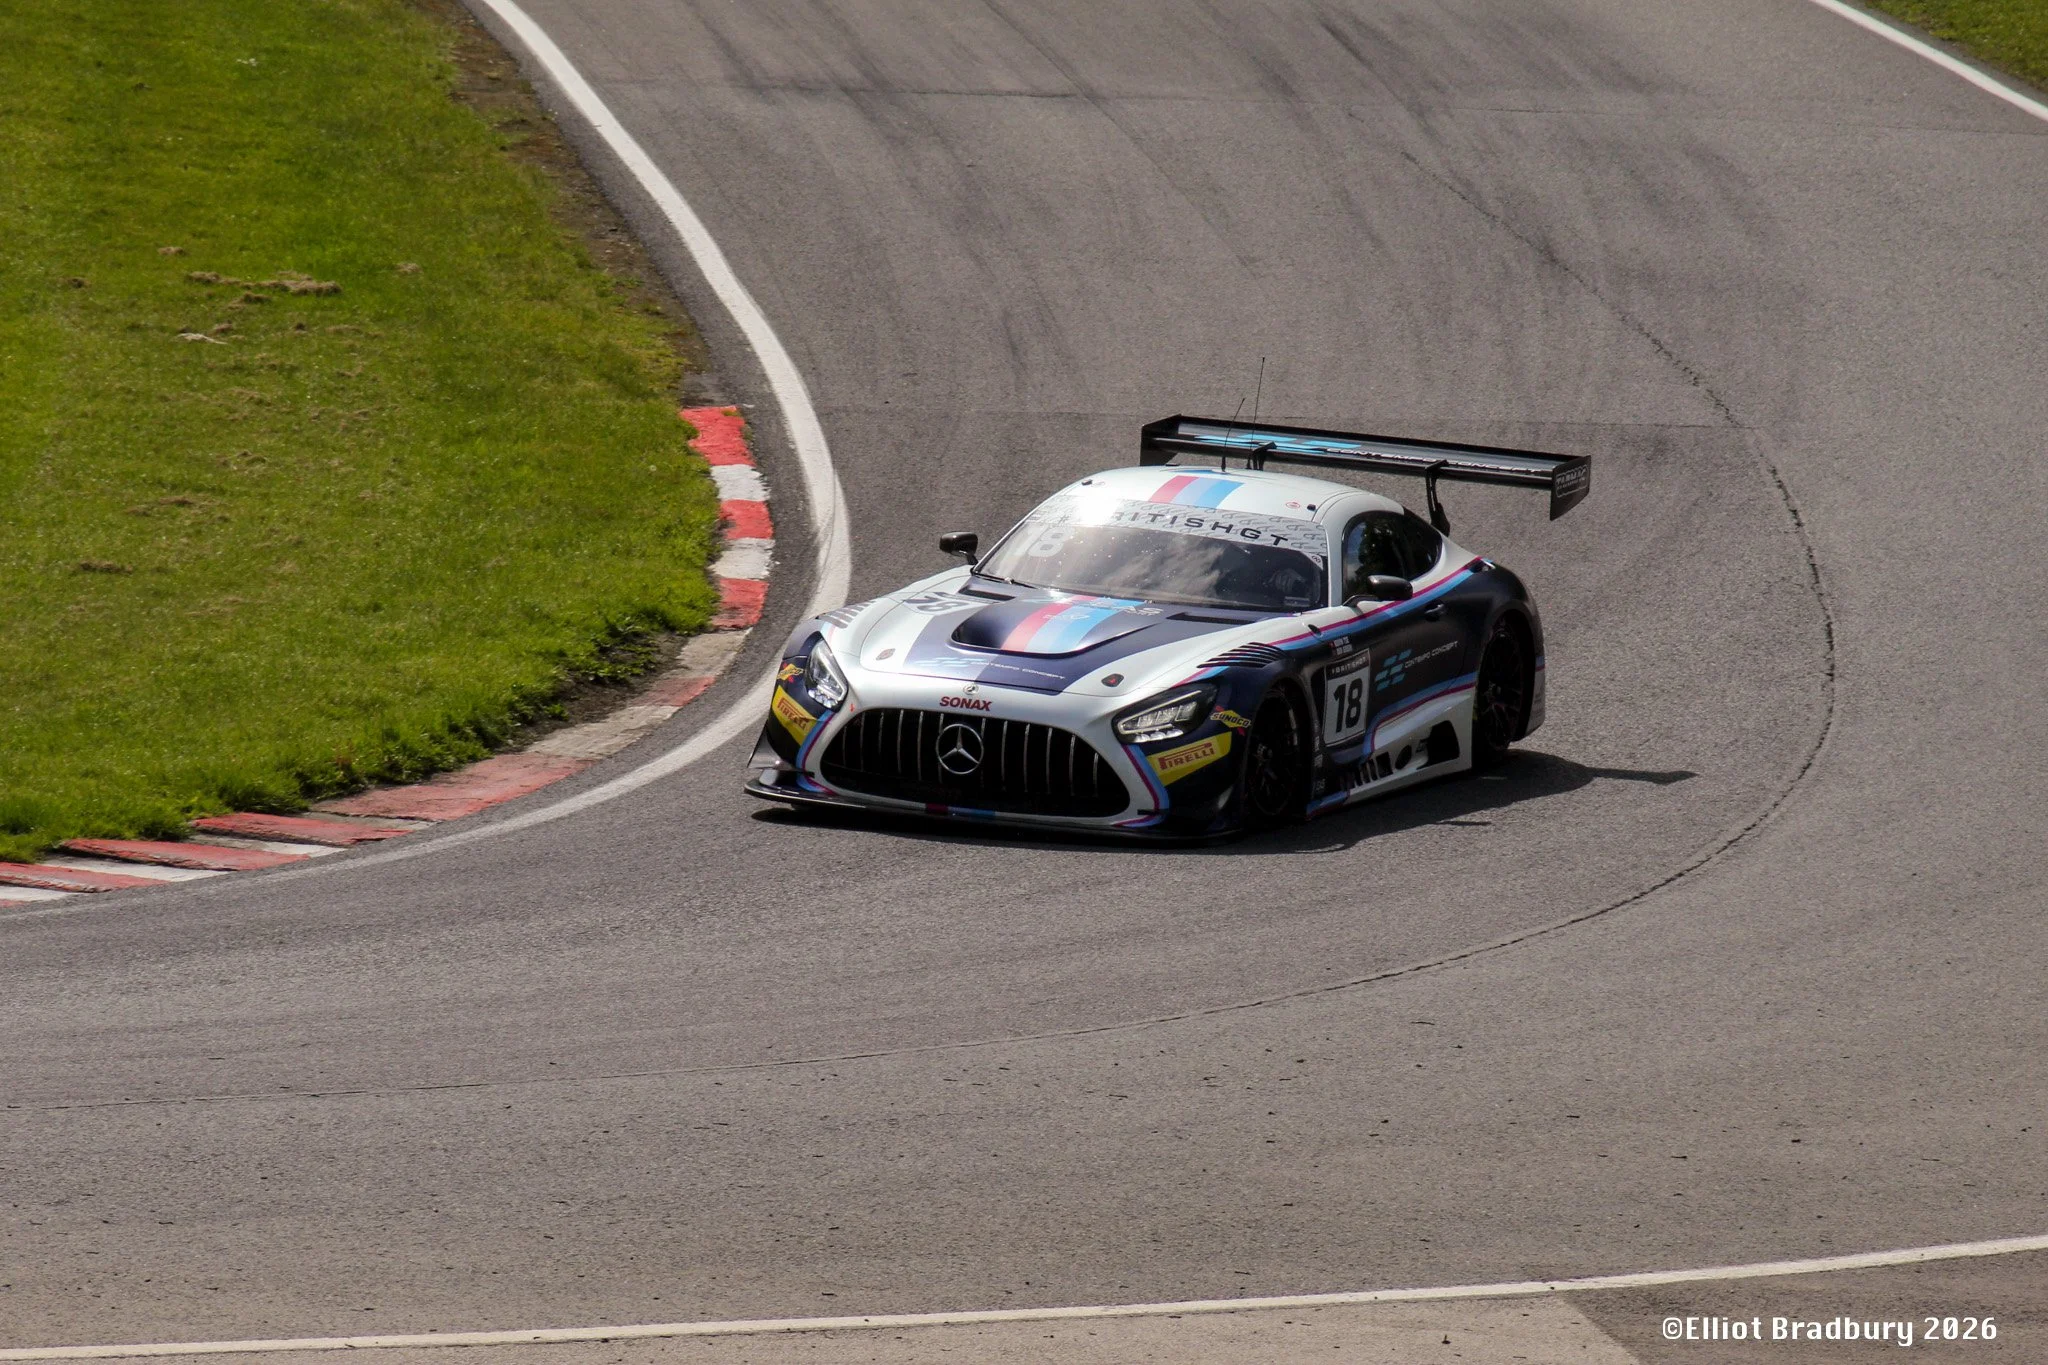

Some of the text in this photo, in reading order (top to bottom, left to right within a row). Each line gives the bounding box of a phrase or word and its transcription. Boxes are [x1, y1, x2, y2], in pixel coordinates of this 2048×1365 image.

[777, 697, 811, 730] PIRELLI
[939, 696, 993, 711] SONAX
[1333, 678, 1363, 733] 18
[1213, 712, 1250, 728] SUNOCO
[1158, 742, 1216, 770] PIRELLI
